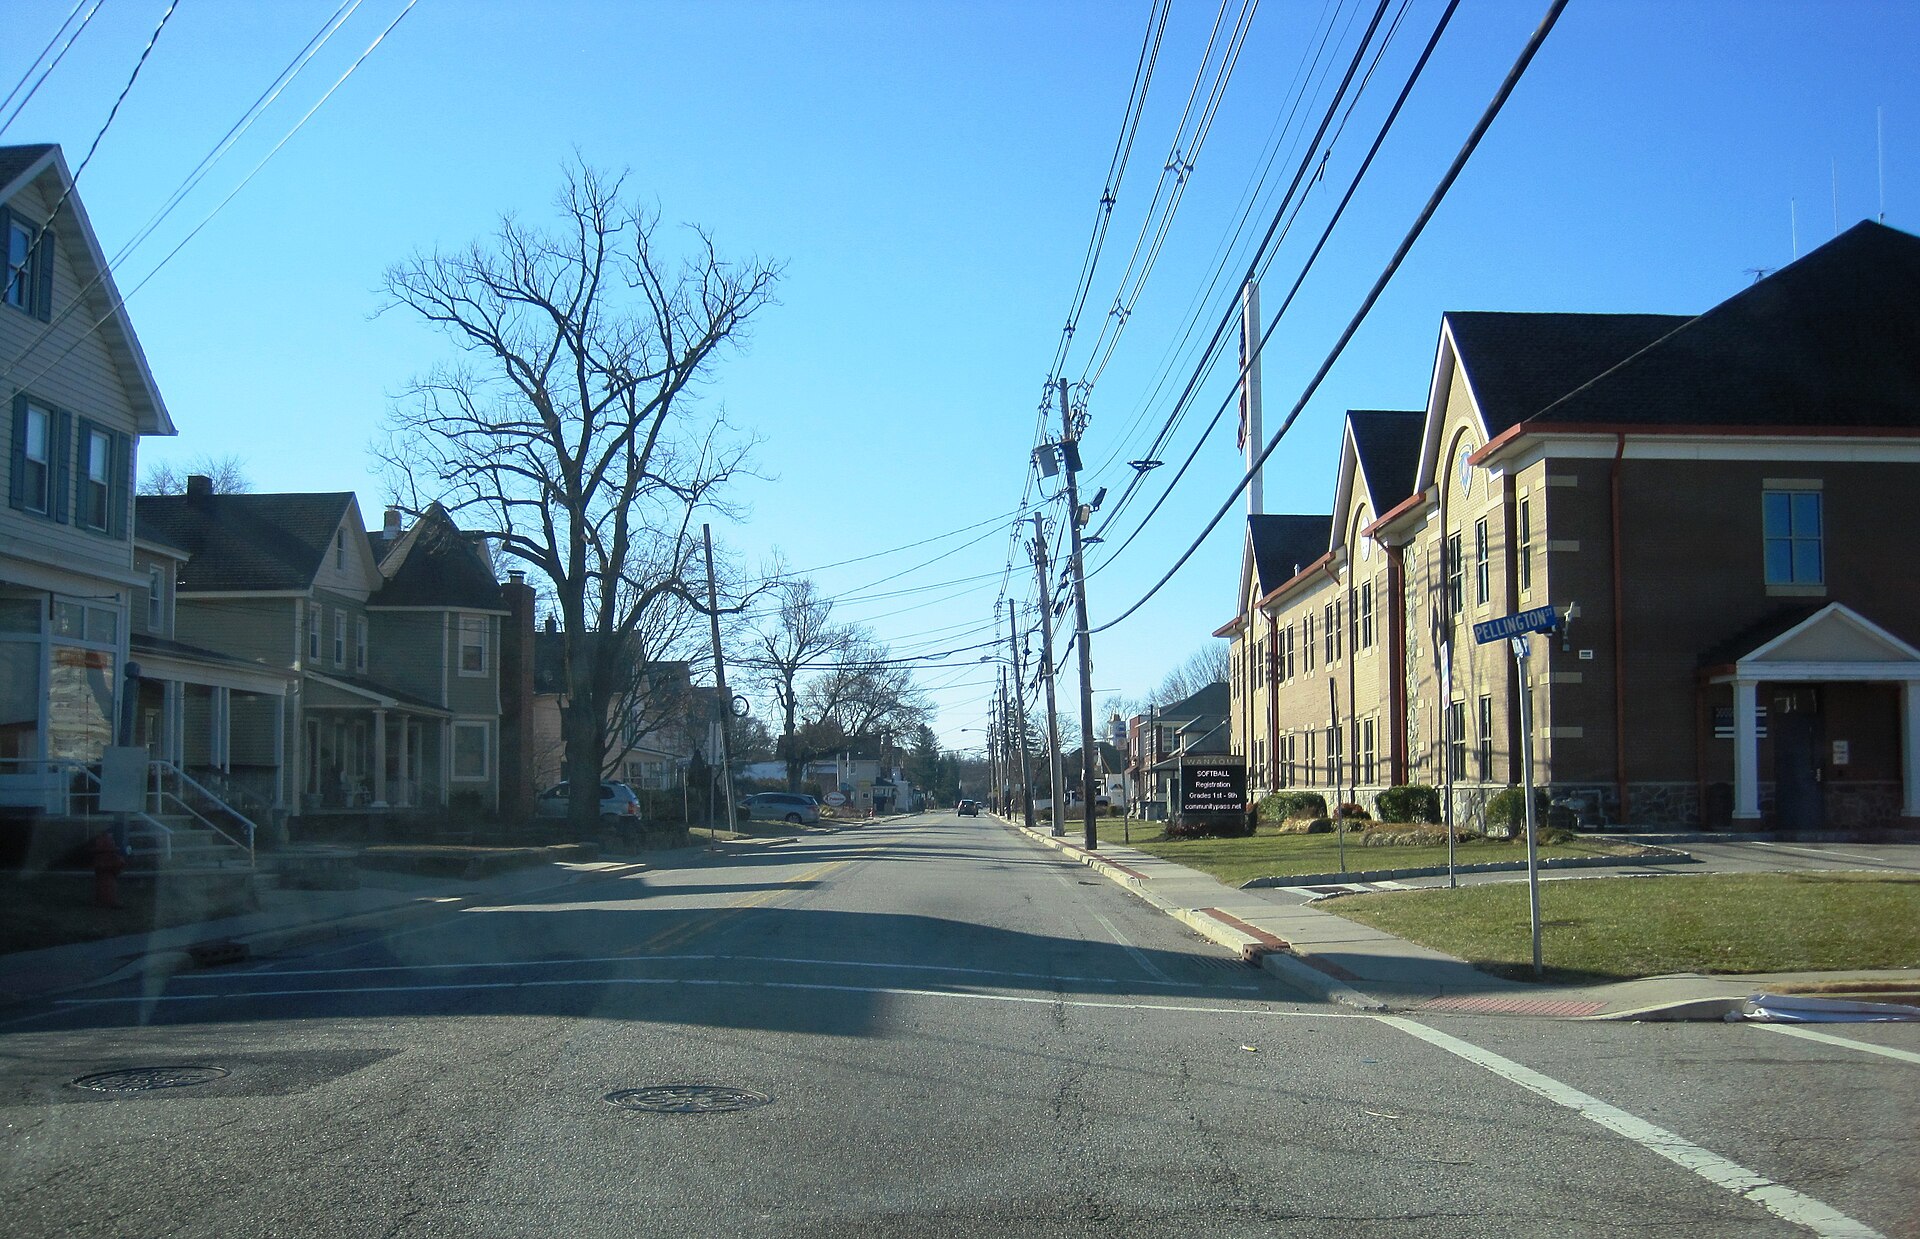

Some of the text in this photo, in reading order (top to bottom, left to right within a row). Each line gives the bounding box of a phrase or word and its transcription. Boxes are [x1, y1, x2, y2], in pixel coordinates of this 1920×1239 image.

[1475, 610, 1546, 641] PELLINGTON
[1195, 781, 1231, 789] Registration
[1185, 803, 1242, 811] communitypass.net
